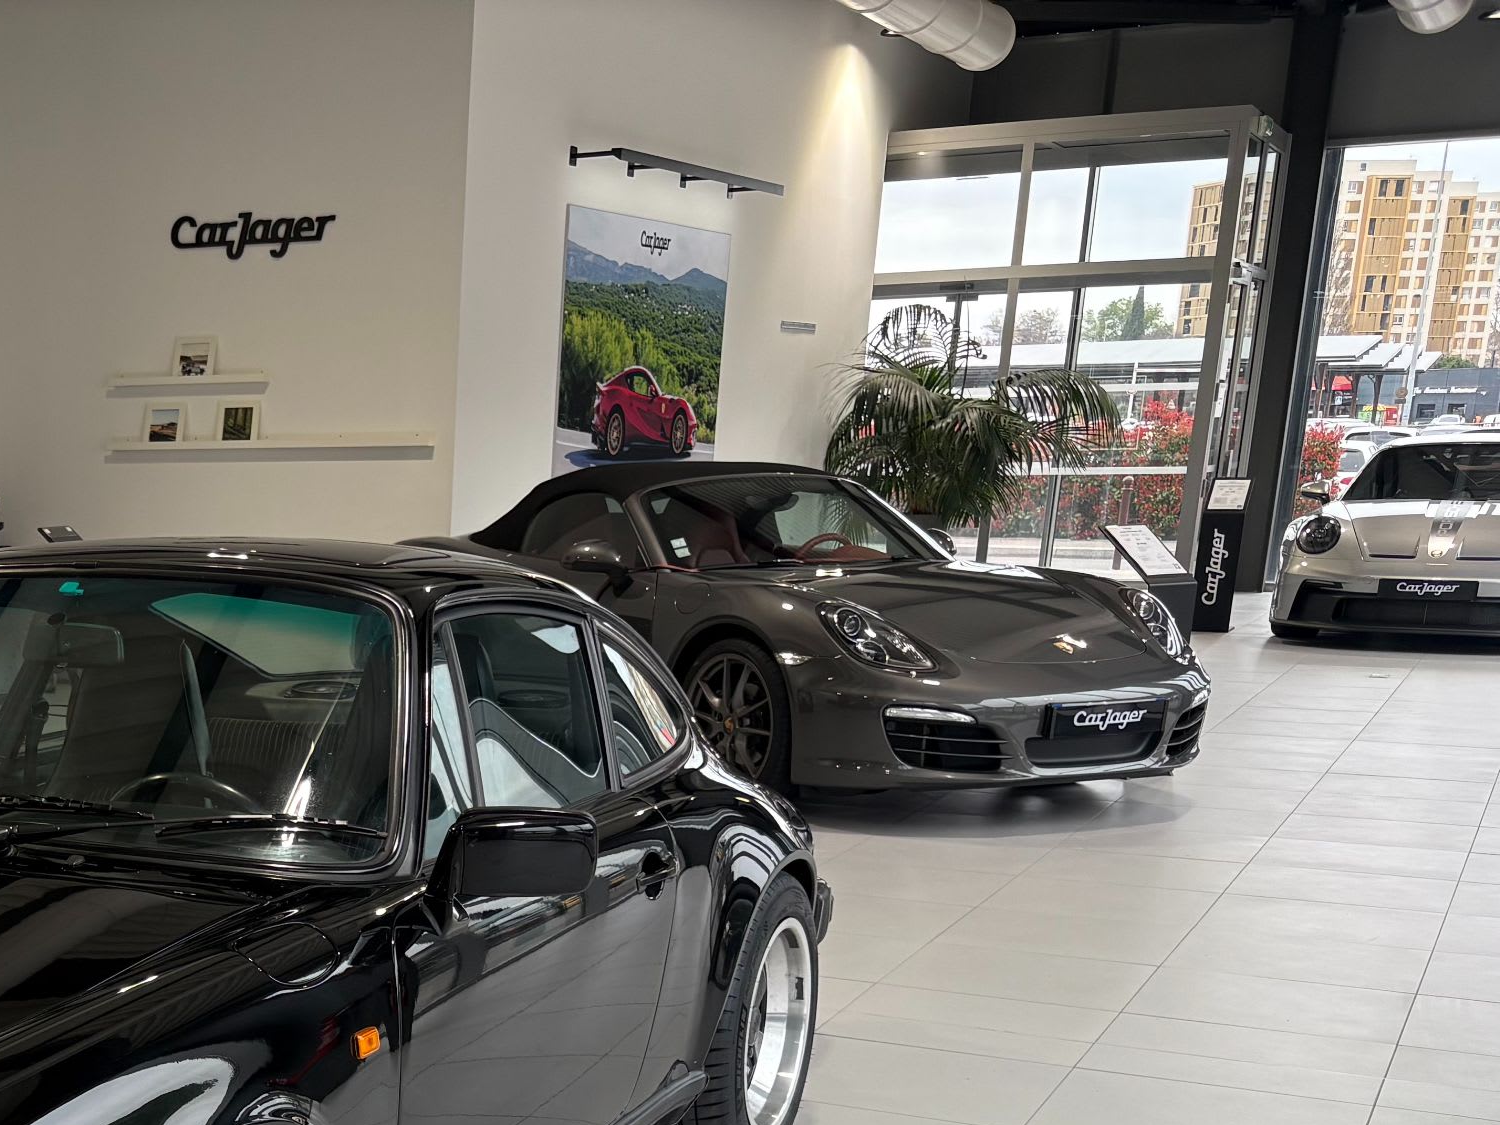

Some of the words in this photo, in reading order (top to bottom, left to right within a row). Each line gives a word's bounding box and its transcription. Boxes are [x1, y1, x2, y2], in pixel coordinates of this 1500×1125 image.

[170, 212, 337, 260] CarJager
[641, 230, 671, 256] CarJager
[1201, 528, 1228, 605] CarJager
[1396, 582, 1460, 596] CarJager
[1073, 709, 1148, 731] CarJager
